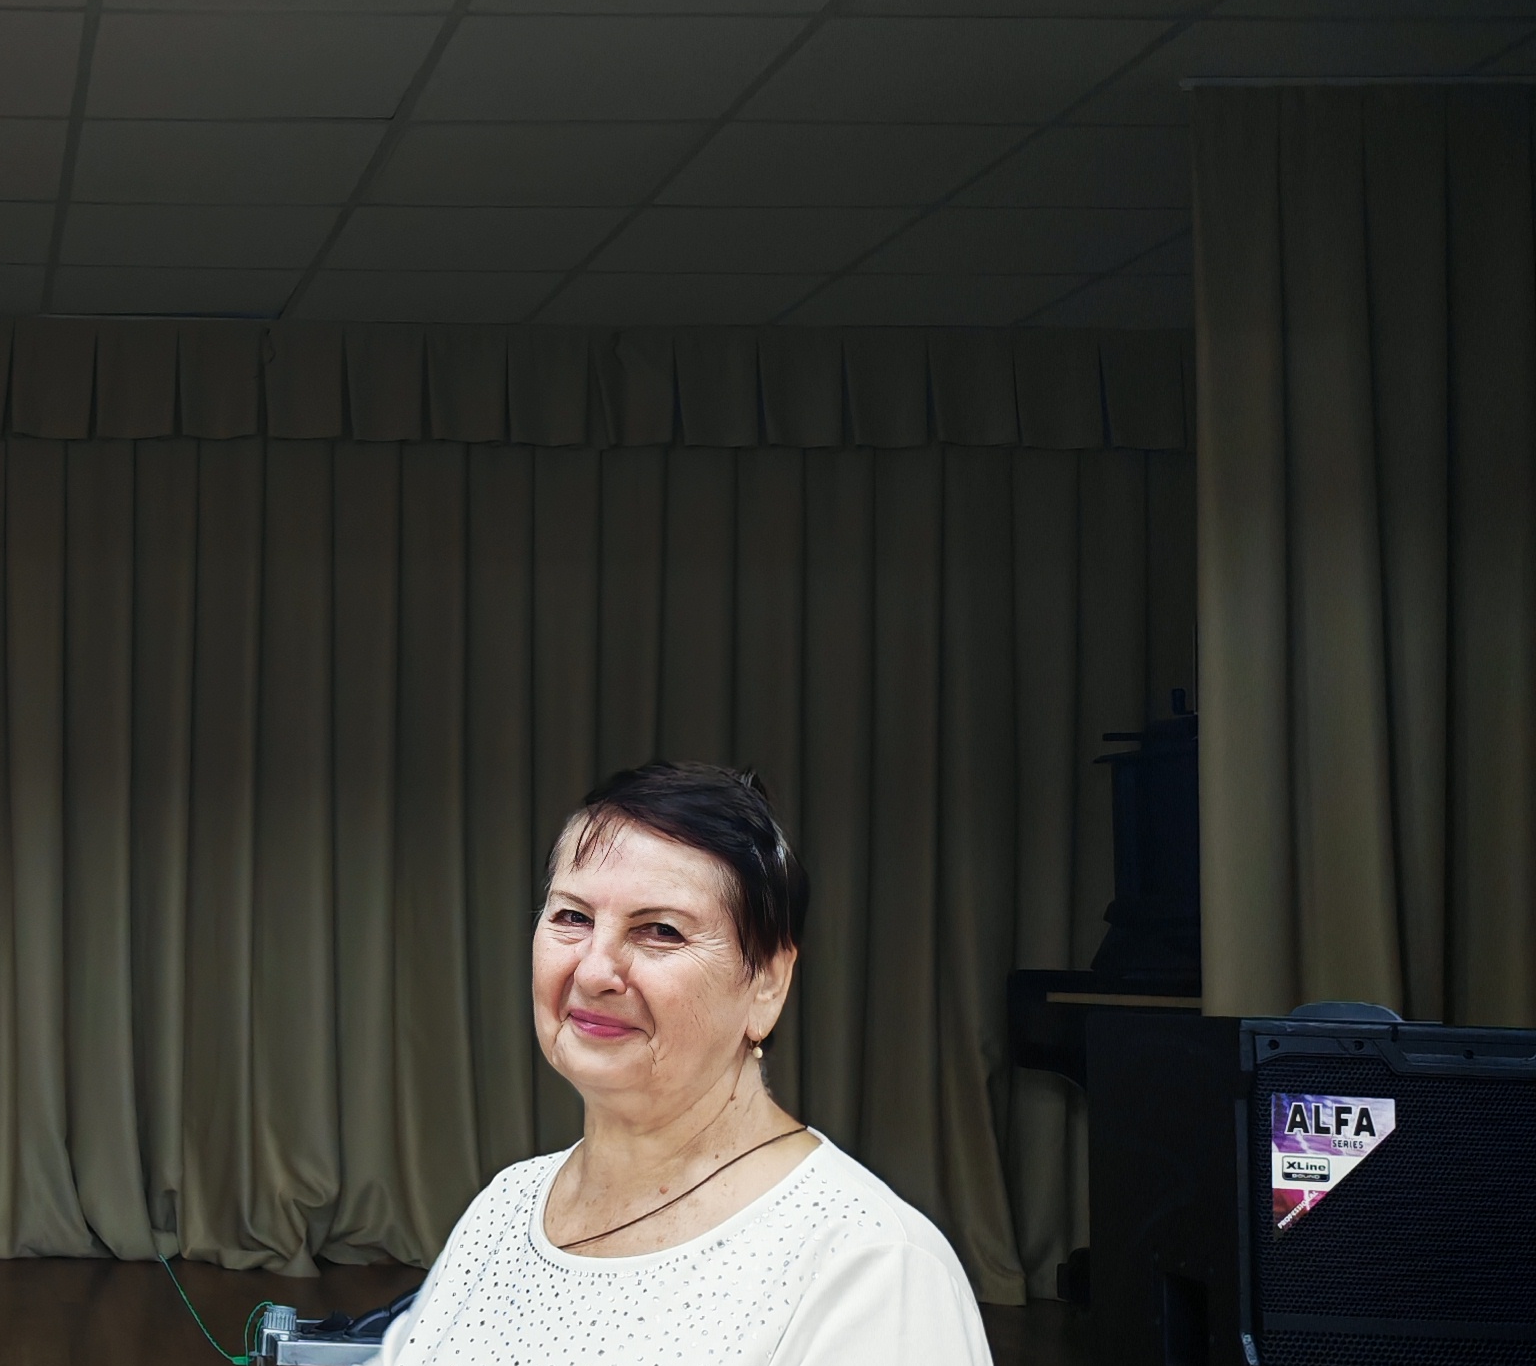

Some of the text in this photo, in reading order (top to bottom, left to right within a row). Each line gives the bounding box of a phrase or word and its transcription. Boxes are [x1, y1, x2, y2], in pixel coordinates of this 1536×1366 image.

[1284, 1102, 1376, 1137] ALFA
[1332, 1139, 1364, 1149] SERIES
[1286, 1161, 1326, 1171] XLine
